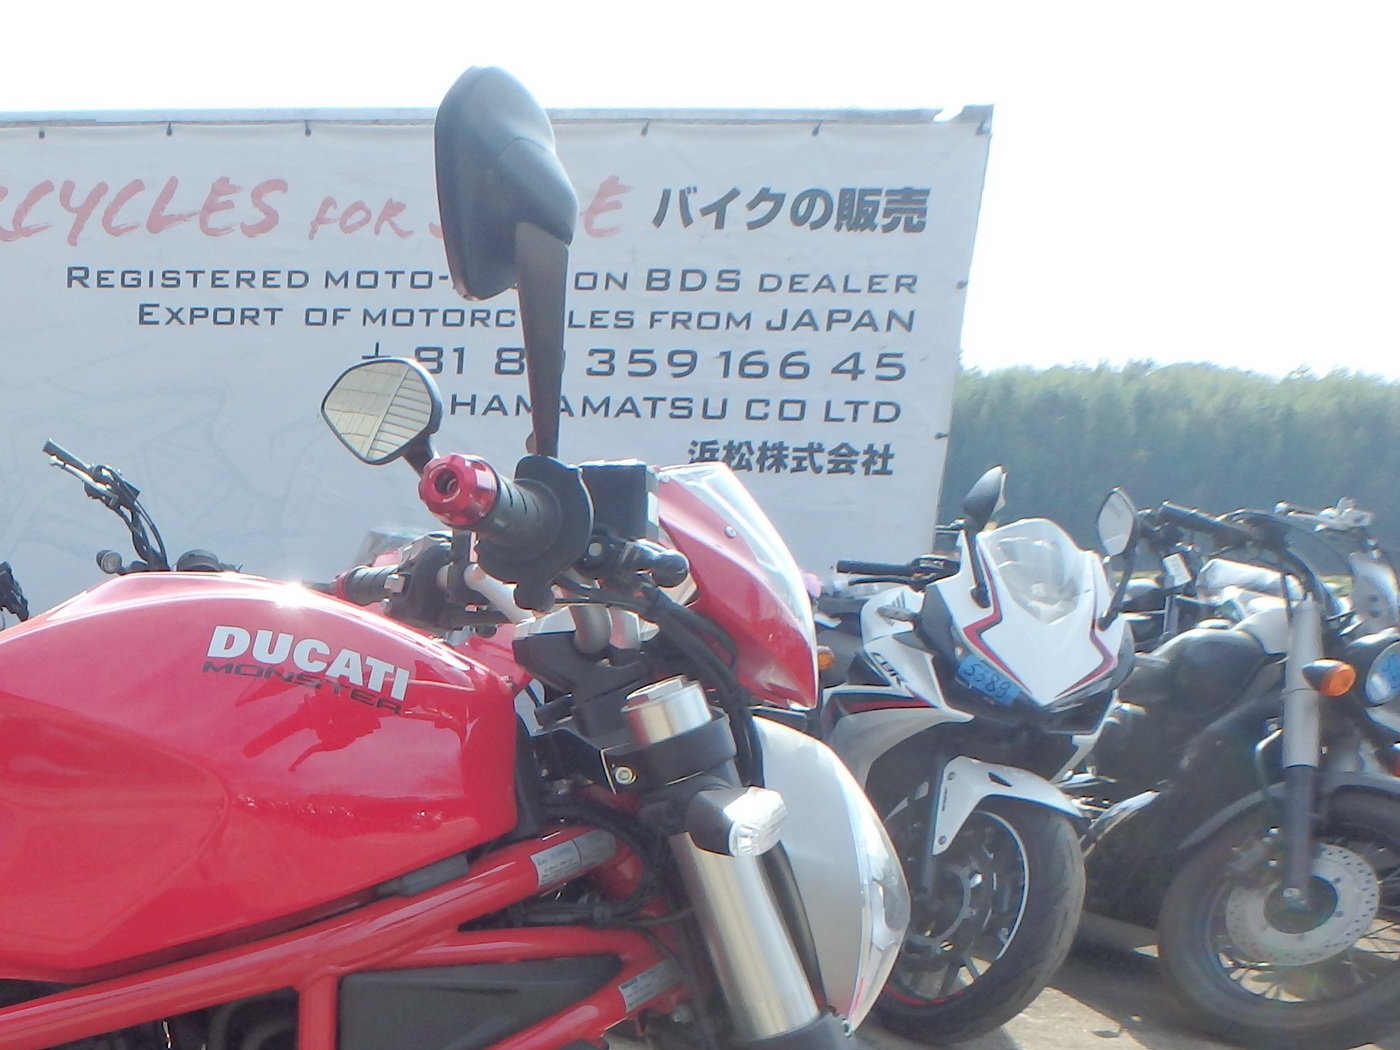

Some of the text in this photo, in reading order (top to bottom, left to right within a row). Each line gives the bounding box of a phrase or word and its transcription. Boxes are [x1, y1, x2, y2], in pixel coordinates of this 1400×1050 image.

[652, 186, 931, 233] バイクの販売
[645, 268, 742, 292] BDS
[758, 273, 918, 294] DEALER
[304, 308, 351, 326] OF
[362, 308, 634, 329] MOTORCLES
[649, 310, 752, 330] FROM
[765, 308, 916, 332] JAPAN
[830, 352, 907, 381] 45
[745, 398, 807, 421] CO
[823, 400, 901, 424] LTD
[686, 440, 895, 476] 浜松株式会社
[206, 625, 410, 701] DUCATI
[202, 660, 403, 715] MONSTER
